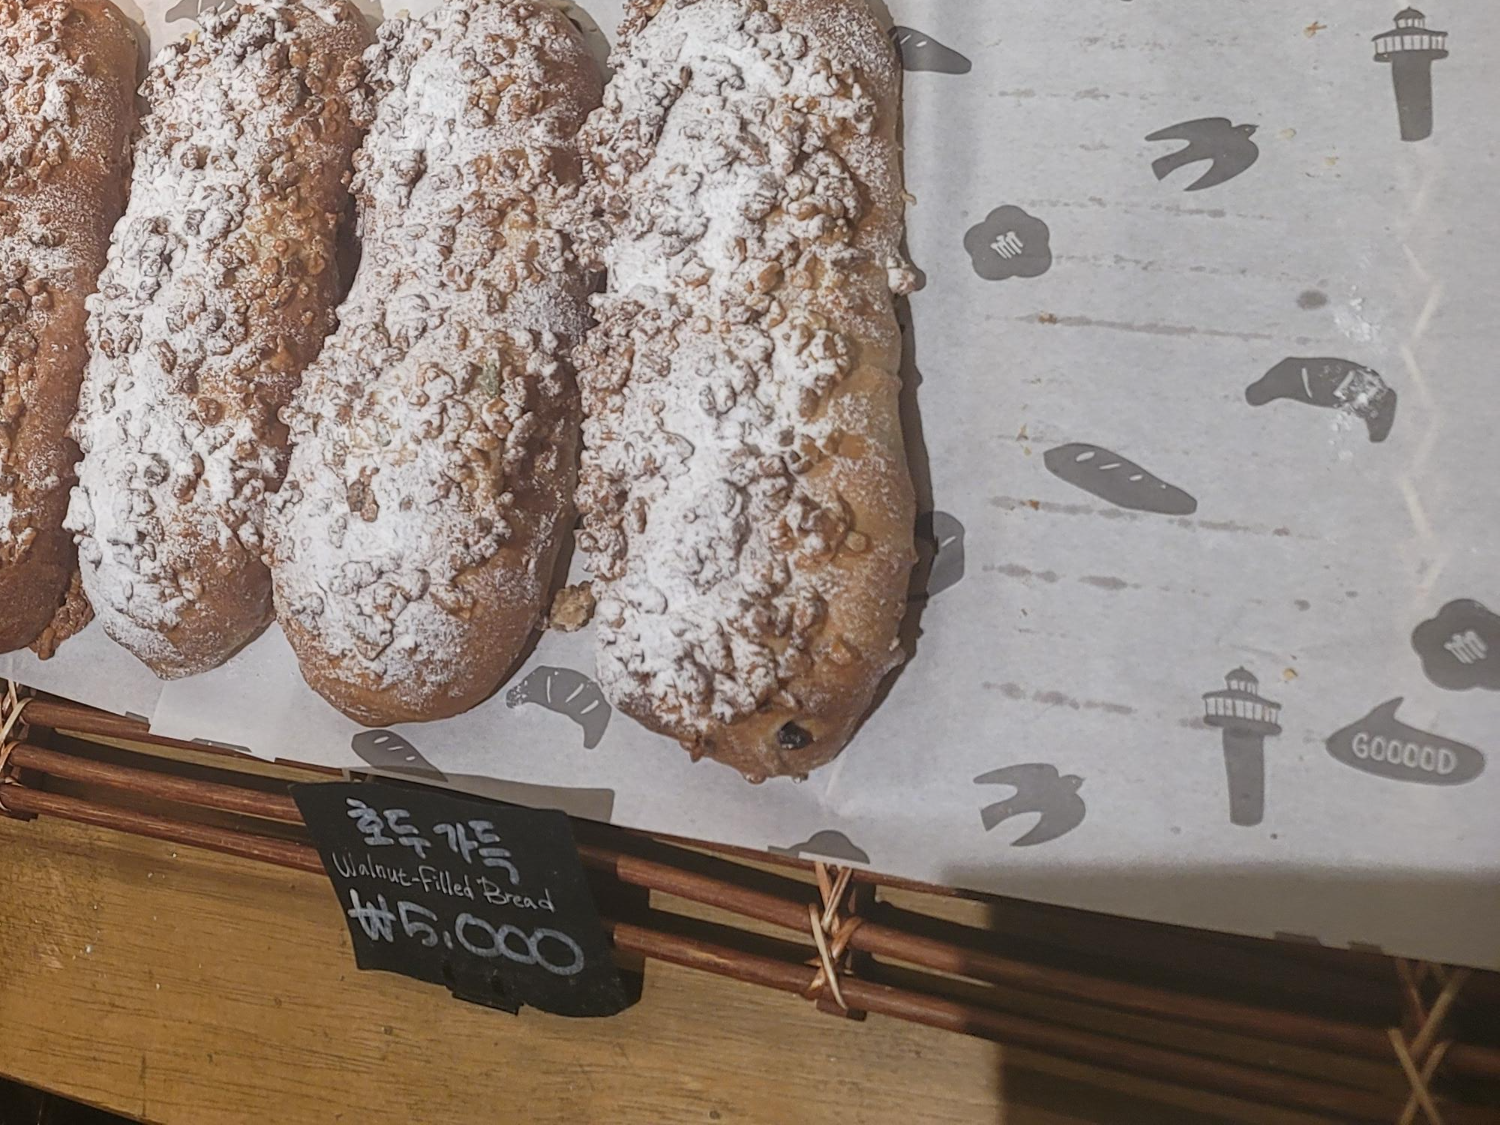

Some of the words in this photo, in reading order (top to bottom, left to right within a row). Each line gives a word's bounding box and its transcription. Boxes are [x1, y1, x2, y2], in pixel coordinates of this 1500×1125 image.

[1352, 732, 1457, 775] GOOOOD
[476, 876, 555, 914] Bread
[348, 888, 585, 976] ₩5,000
